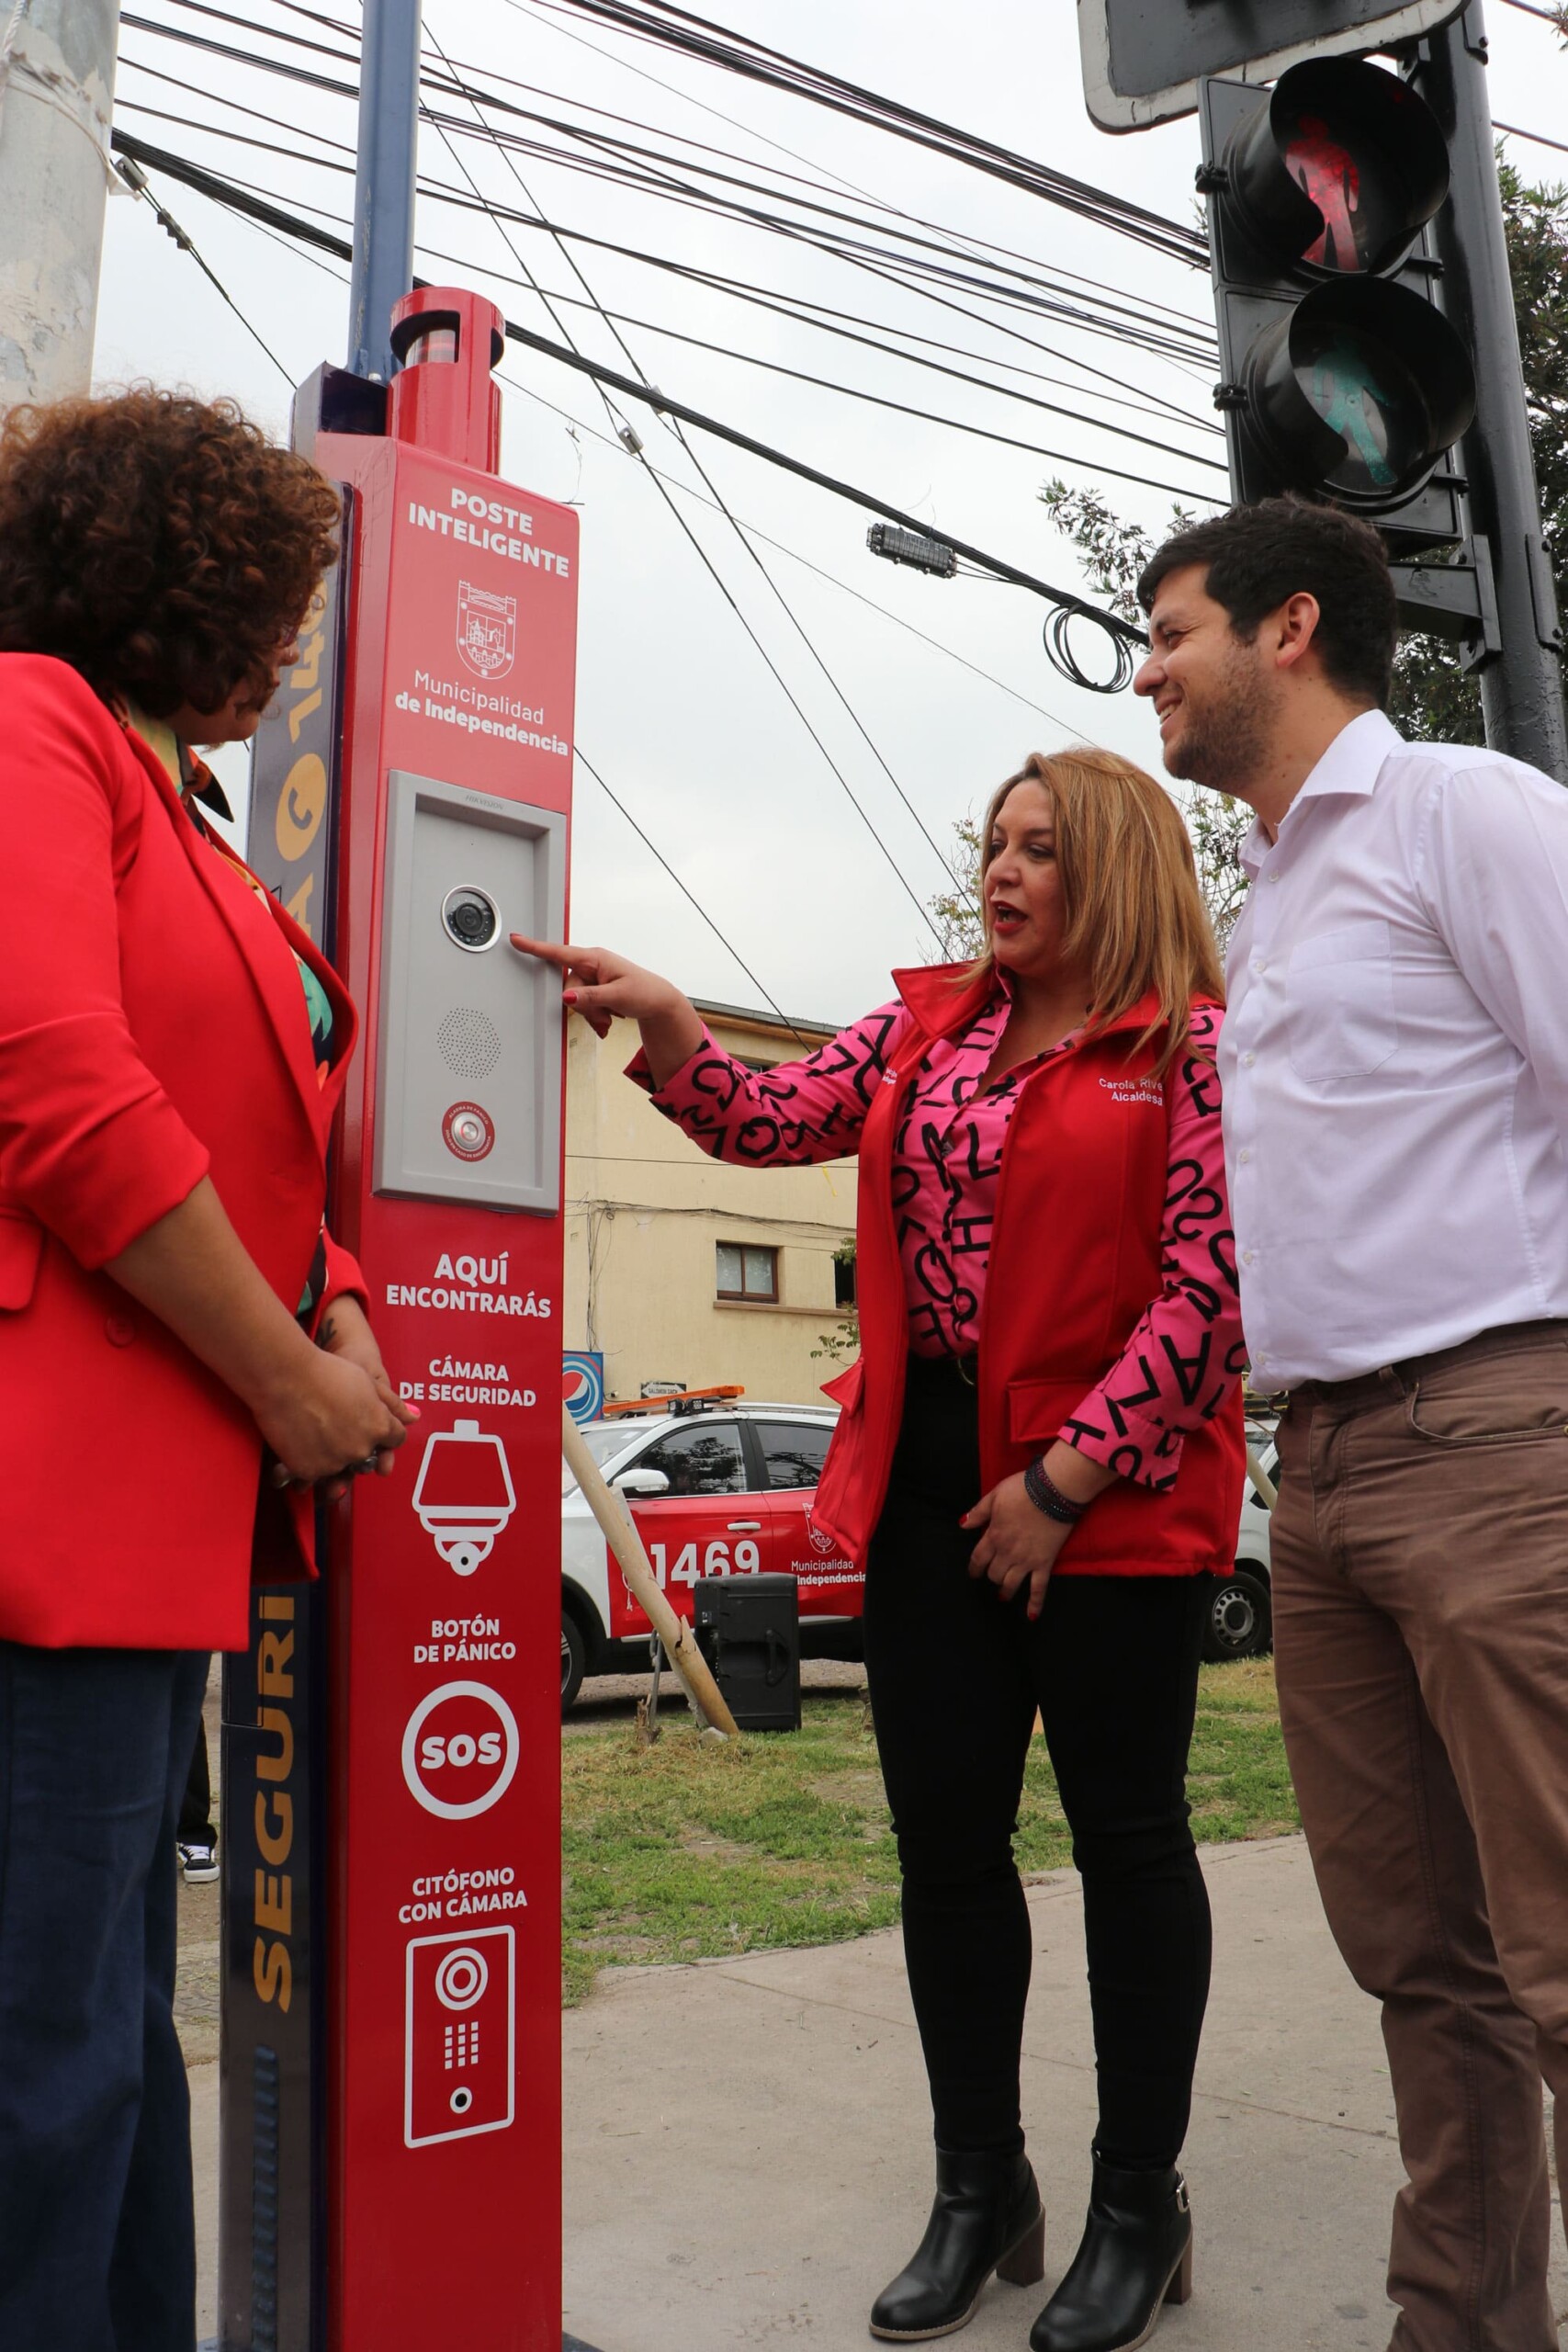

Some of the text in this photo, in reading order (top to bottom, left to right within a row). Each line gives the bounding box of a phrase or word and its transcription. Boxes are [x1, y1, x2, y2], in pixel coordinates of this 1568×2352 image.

[451, 488, 533, 536] POSTE
[409, 503, 570, 578] INTELIGENTE
[414, 670, 544, 725] Municipalidad
[395, 692, 568, 756] de Independencia
[465, 795, 503, 809] HIKVISION
[1099, 1078, 1135, 1091] Carola
[1111, 1091, 1163, 1106] Alcaldesa
[434, 1251, 509, 1288] AQUÍ
[386, 1284, 551, 1318] ENCONTRARÁS
[429, 1354, 509, 1382] CÁMARA
[400, 1382, 536, 1407] DE SEGURIDAD
[650, 1540, 760, 1590] 1469
[432, 1613, 500, 1638] BOTÓN
[414, 1639, 516, 1663] DE PÁNICO
[421, 1732, 502, 1770] SOS
[412, 1867, 514, 1896] CITÓFONO
[399, 1890, 528, 1924] CON CÁMARA
